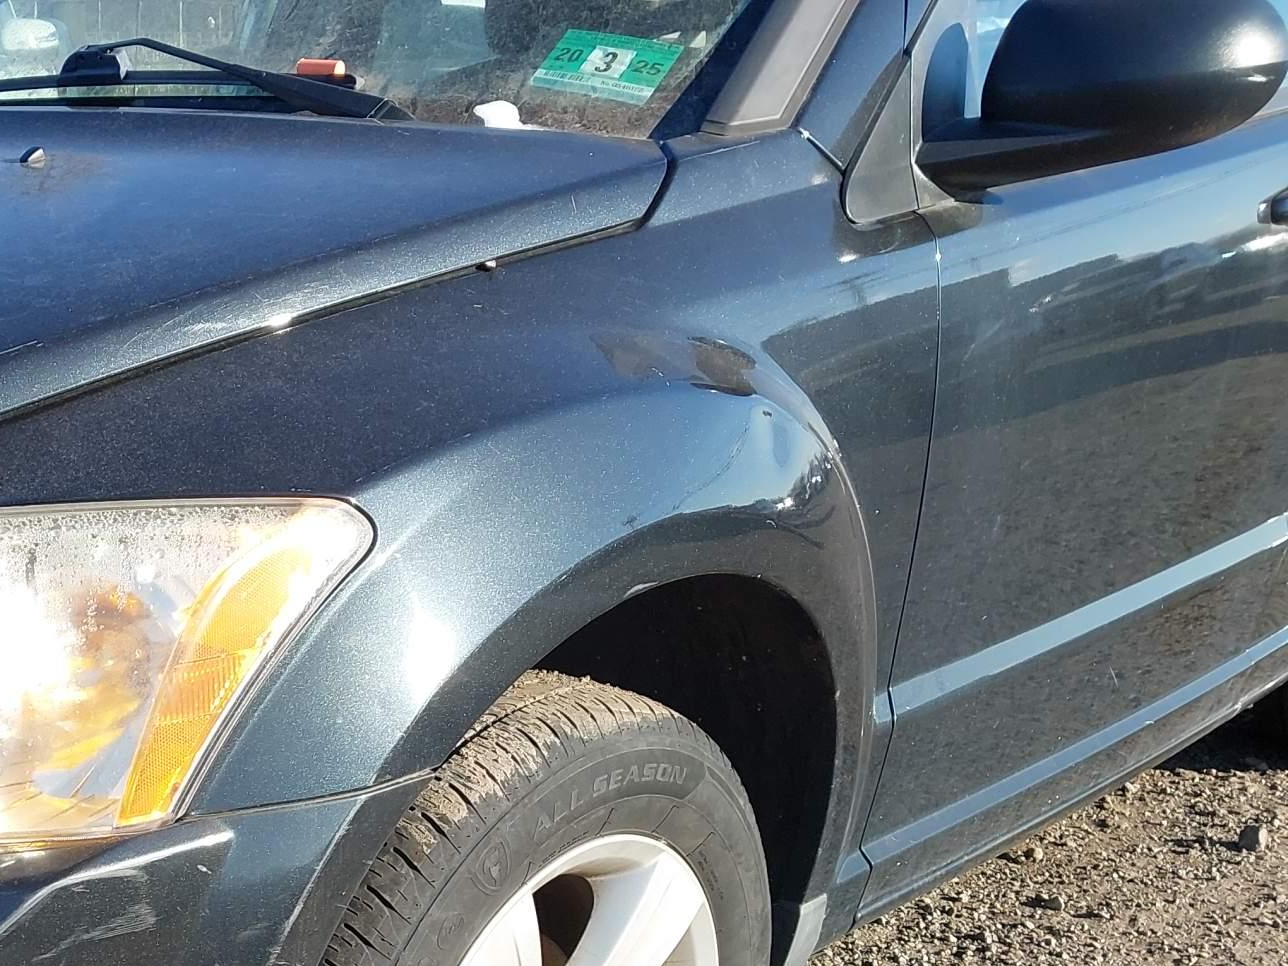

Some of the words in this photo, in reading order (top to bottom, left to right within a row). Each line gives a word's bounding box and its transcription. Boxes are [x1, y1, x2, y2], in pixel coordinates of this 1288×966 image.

[553, 47, 584, 63] 20
[594, 51, 619, 73] 3
[631, 60, 664, 76] 25
[533, 788, 585, 842] ALL
[592, 763, 687, 798] SEASON
